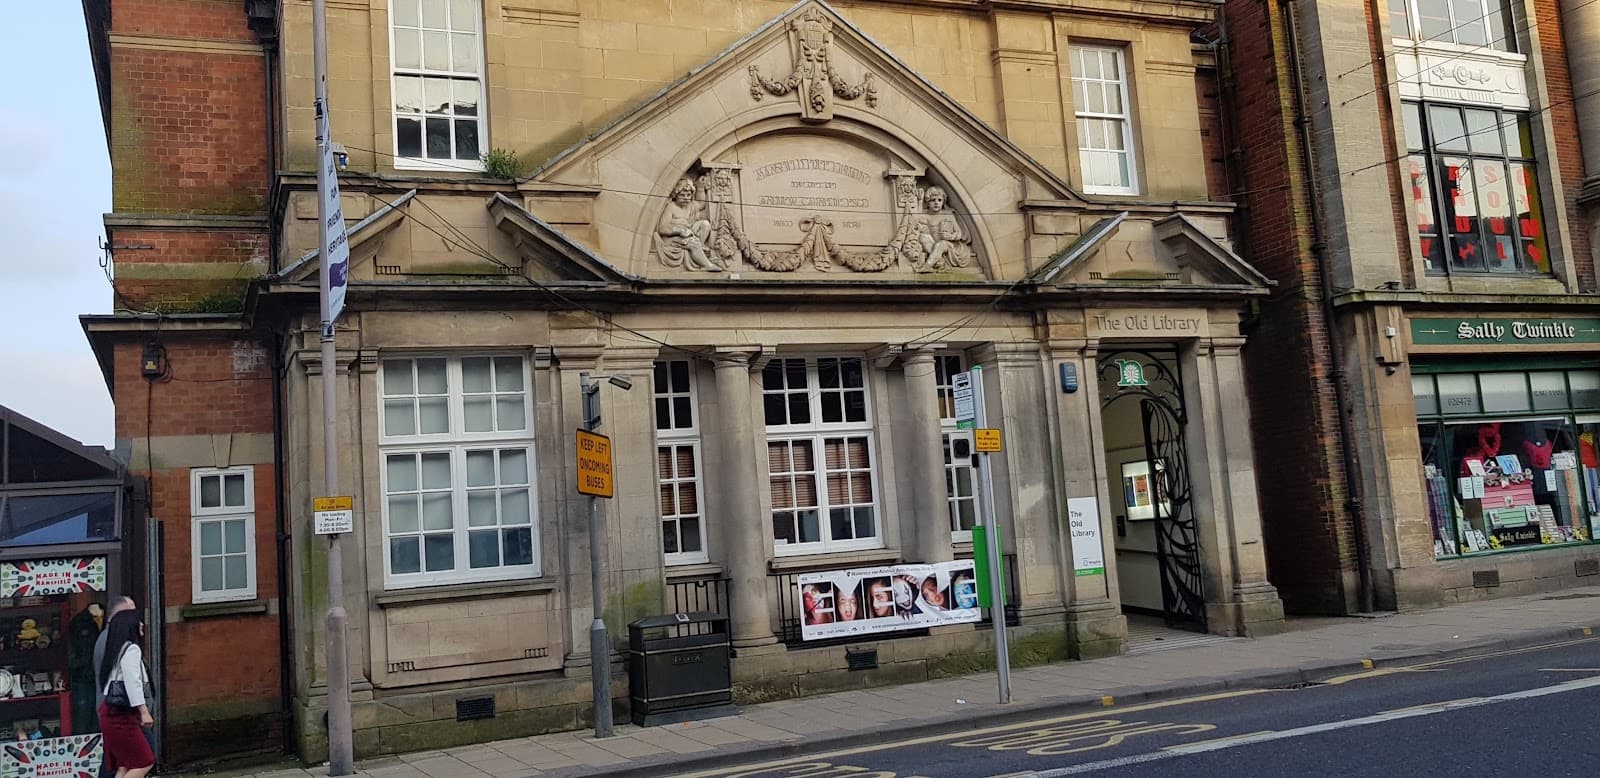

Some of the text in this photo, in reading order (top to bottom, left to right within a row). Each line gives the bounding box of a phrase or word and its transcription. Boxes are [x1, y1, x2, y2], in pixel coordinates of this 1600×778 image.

[1094, 314, 1201, 333] The Old Library
[1457, 321, 1575, 341] Sally Twinkle
[580, 439, 607, 454] KEEP LEFT
[580, 458, 610, 475] ONCOMING
[586, 475, 605, 489] BUSES
[1070, 511, 1082, 519] The
[1071, 520, 1083, 528] Old
[1072, 529, 1095, 538] Library
[36, 578, 71, 586] MANSFIELD
[36, 762, 59, 770] MADE
[36, 768, 72, 777] MANSFIELD
